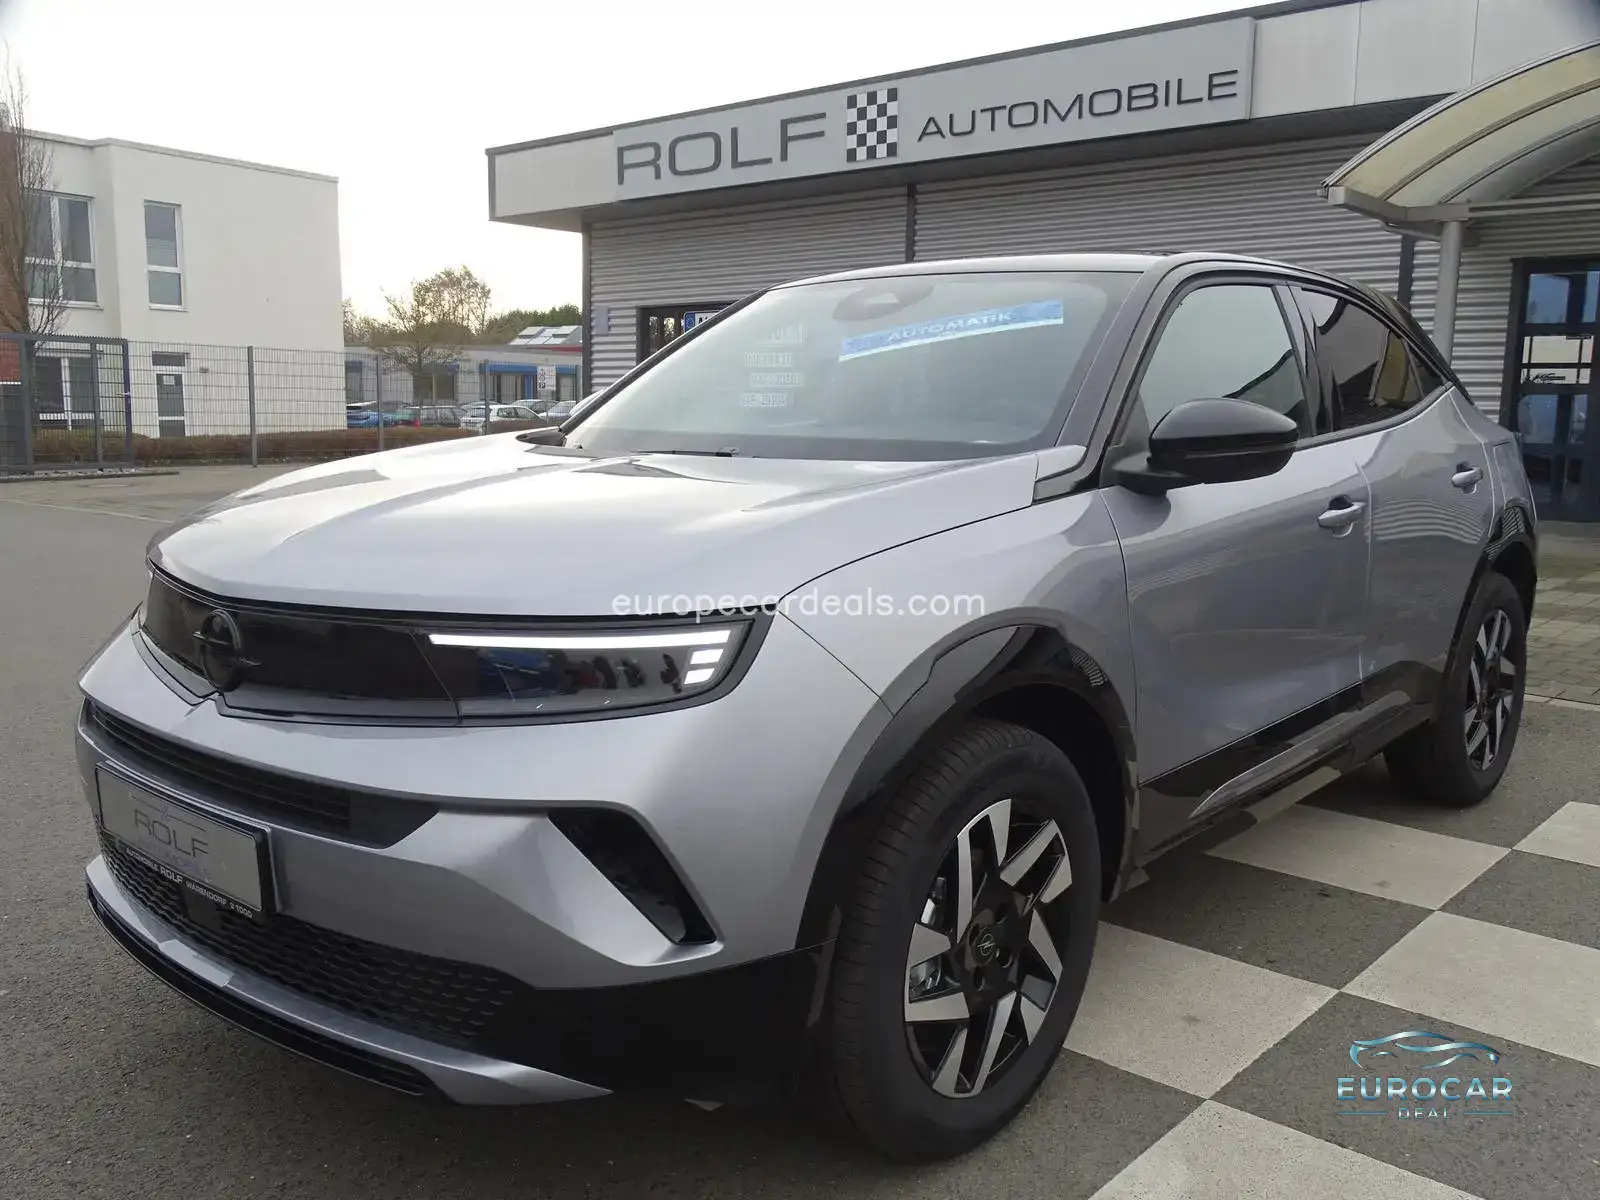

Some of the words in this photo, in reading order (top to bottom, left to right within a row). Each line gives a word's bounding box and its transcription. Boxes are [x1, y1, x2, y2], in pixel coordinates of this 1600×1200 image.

[617, 112, 826, 186] ROLF
[916, 69, 1239, 143] AUTOMOBILE
[134, 808, 209, 857] ROLF
[160, 866, 183, 884] ROLF
